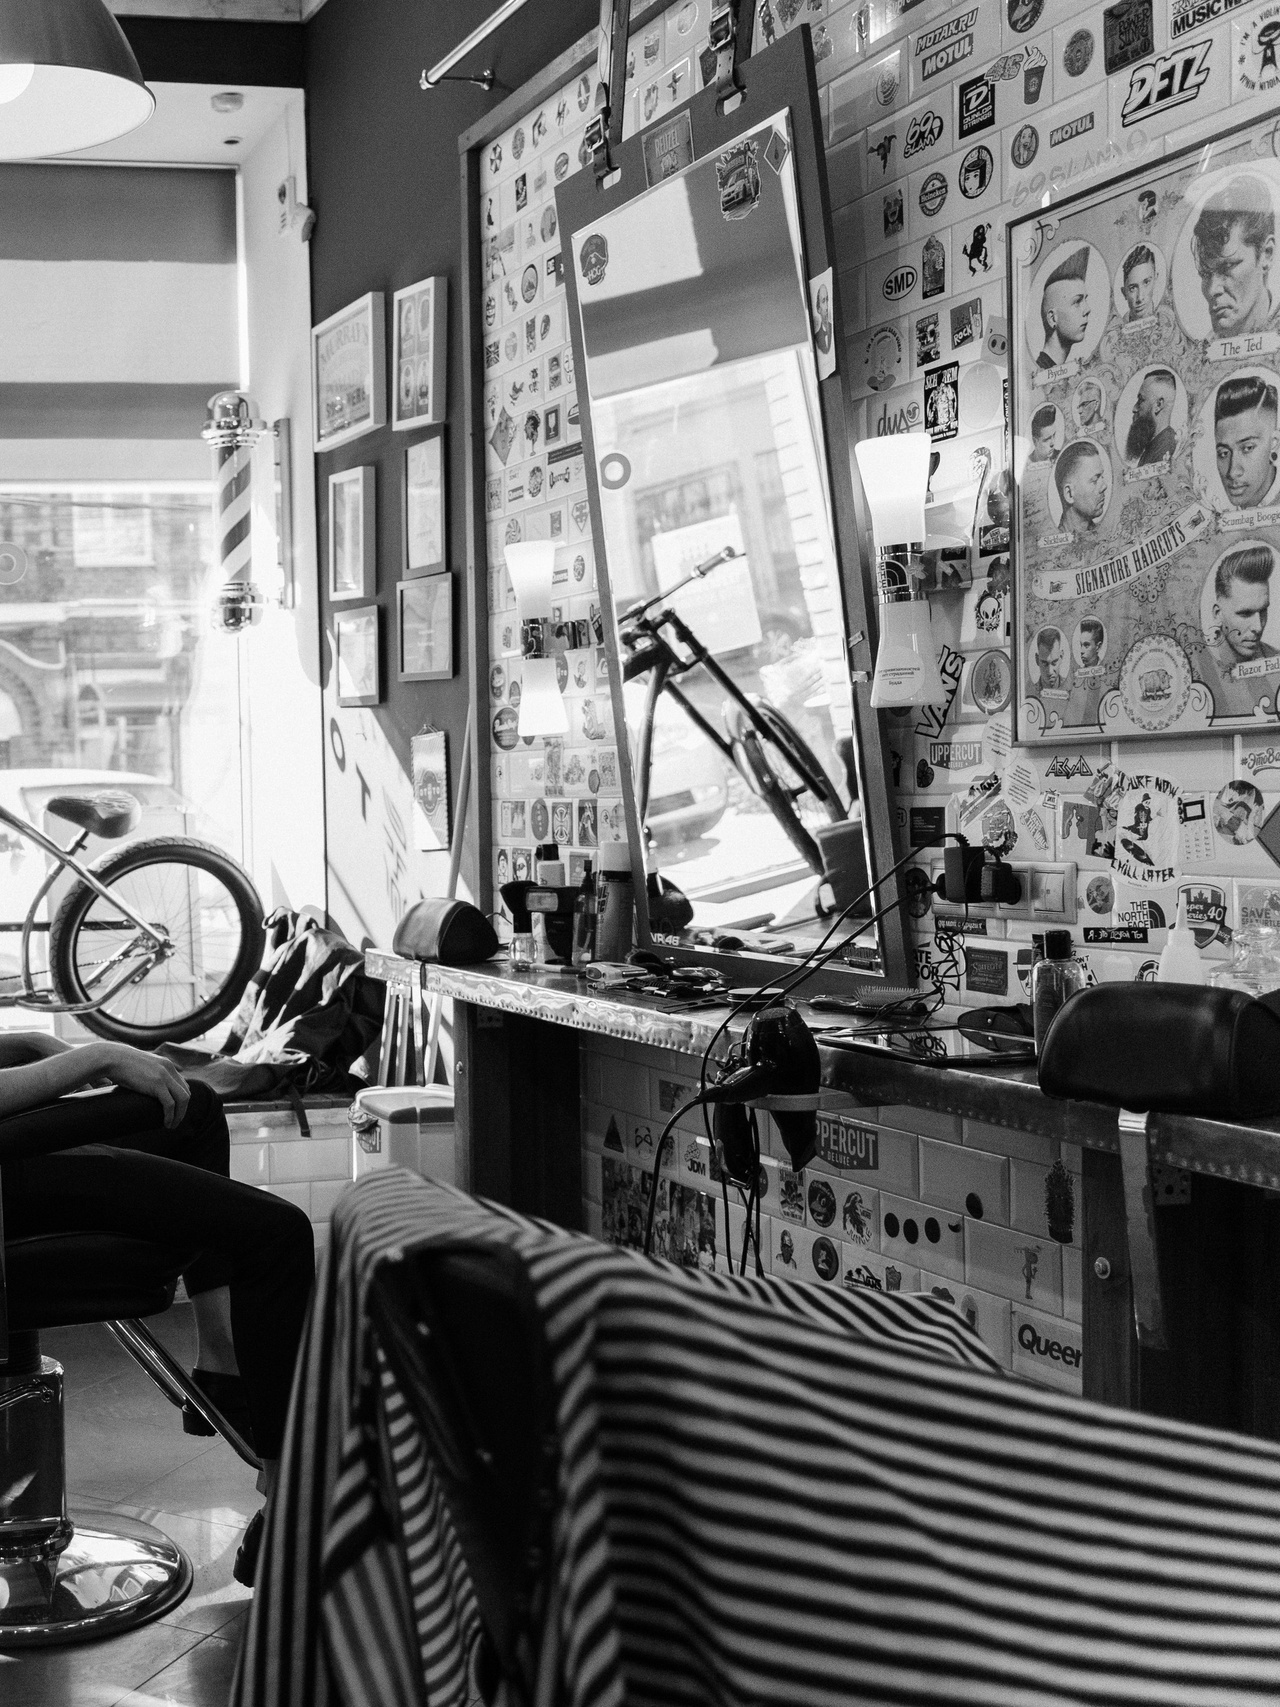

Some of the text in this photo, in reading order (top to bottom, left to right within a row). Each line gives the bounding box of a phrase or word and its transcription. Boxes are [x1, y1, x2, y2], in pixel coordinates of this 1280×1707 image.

[1173, 0, 1220, 37] MUSIC
[922, 34, 973, 78] MOTUL
[963, 105, 993, 125] DUNLOP
[963, 112, 993, 131] STRINGS
[907, 111, 935, 144] 69
[1051, 115, 1093, 145] MOTUL
[921, 185, 946, 202] Heineken
[885, 271, 915, 296] SMD
[953, 325, 972, 346] ROCK
[1221, 337, 1263, 356] The Ted
[1047, 367, 1068, 380] Psycho
[1222, 513, 1255, 528] Scumbag
[1075, 521, 1186, 595] SIGNATURE HAIRCUTS
[1238, 659, 1280, 678] Razor Fad
[931, 743, 981, 764] UPPERCUT
[1155, 777, 1180, 798] NOW
[1141, 867, 1175, 883] LATER
[1130, 901, 1148, 911] THE
[1186, 903, 1224, 922] uper 40
[1241, 906, 1272, 919] SAVE
[1118, 911, 1149, 922] NORTH
[1186, 911, 1208, 921] eries
[650, 932, 680, 946] VR46
[816, 1120, 877, 1167] PERCUT
[687, 1159, 706, 1176] JDM
[827, 1151, 851, 1167] DELUXE
[1018, 1323, 1083, 1368] Queer
